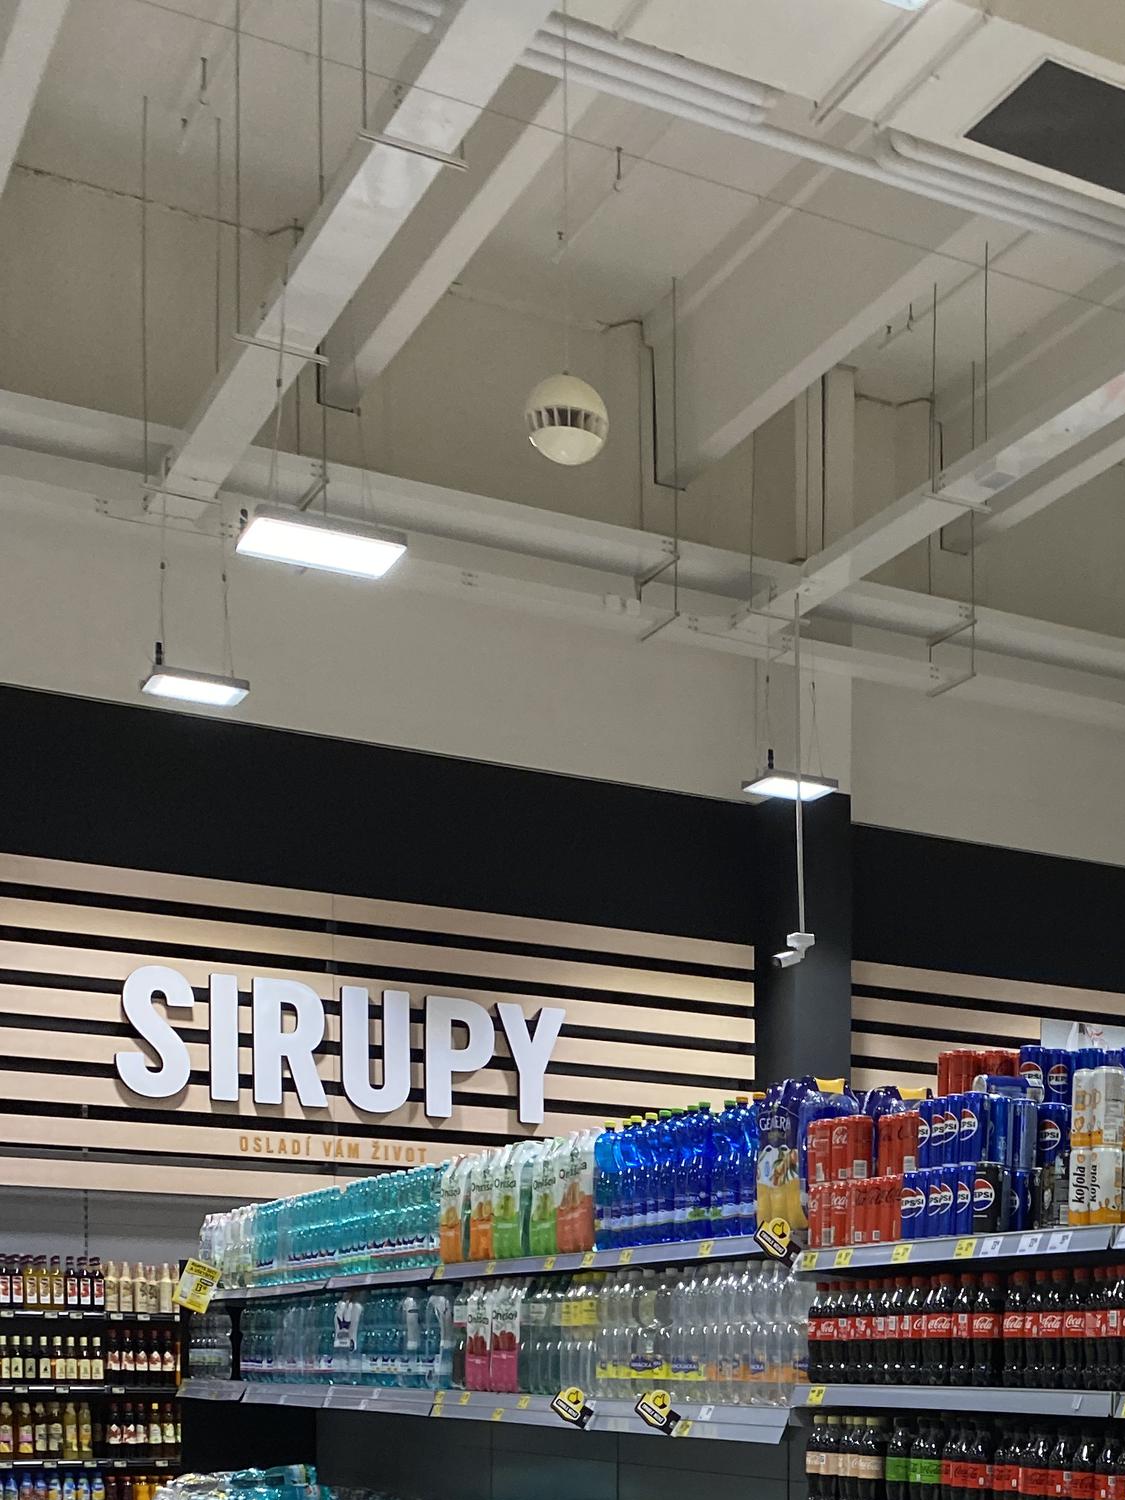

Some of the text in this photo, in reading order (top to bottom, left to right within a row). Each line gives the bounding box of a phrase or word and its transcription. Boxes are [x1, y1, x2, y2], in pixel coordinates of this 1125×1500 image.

[113, 964, 567, 1125] SIRUPY
[239, 1134, 428, 1163] OSLADÍ VÁM ŽIVOT
[1072, 1165, 1086, 1204] kofola
